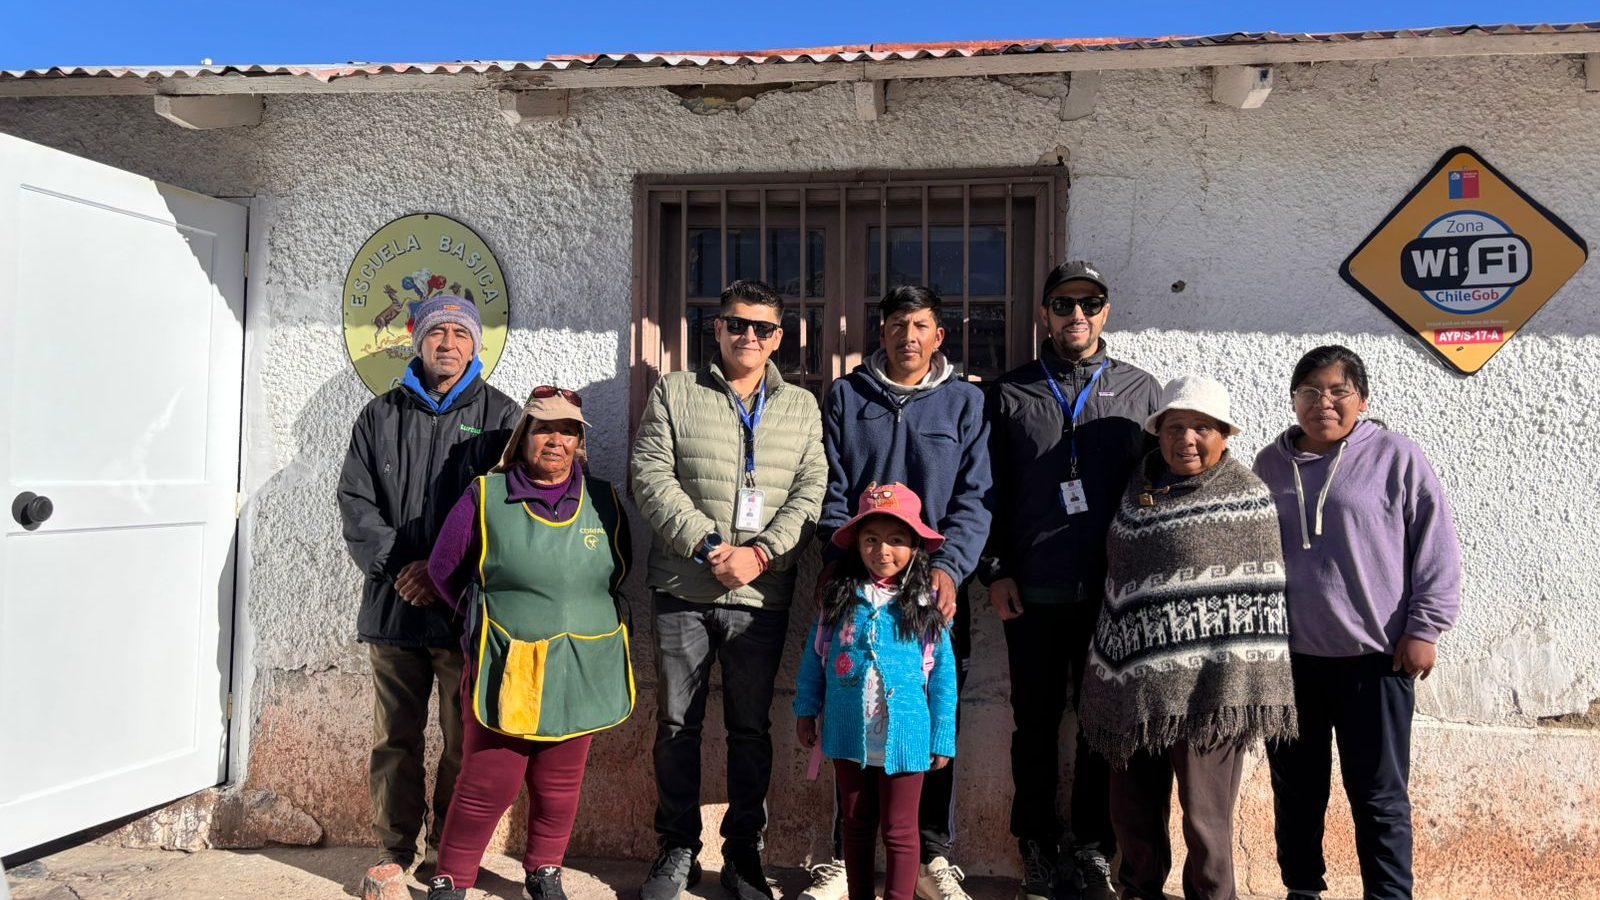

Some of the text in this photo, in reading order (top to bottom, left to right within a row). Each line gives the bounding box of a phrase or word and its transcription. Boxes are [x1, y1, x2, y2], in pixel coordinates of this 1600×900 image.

[1446, 219, 1484, 234] Zona
[351, 234, 499, 308] ESCUELA BASICA
[1435, 289, 1500, 303] ChileGob
[1439, 330, 1500, 342] AYP/S-17-A
